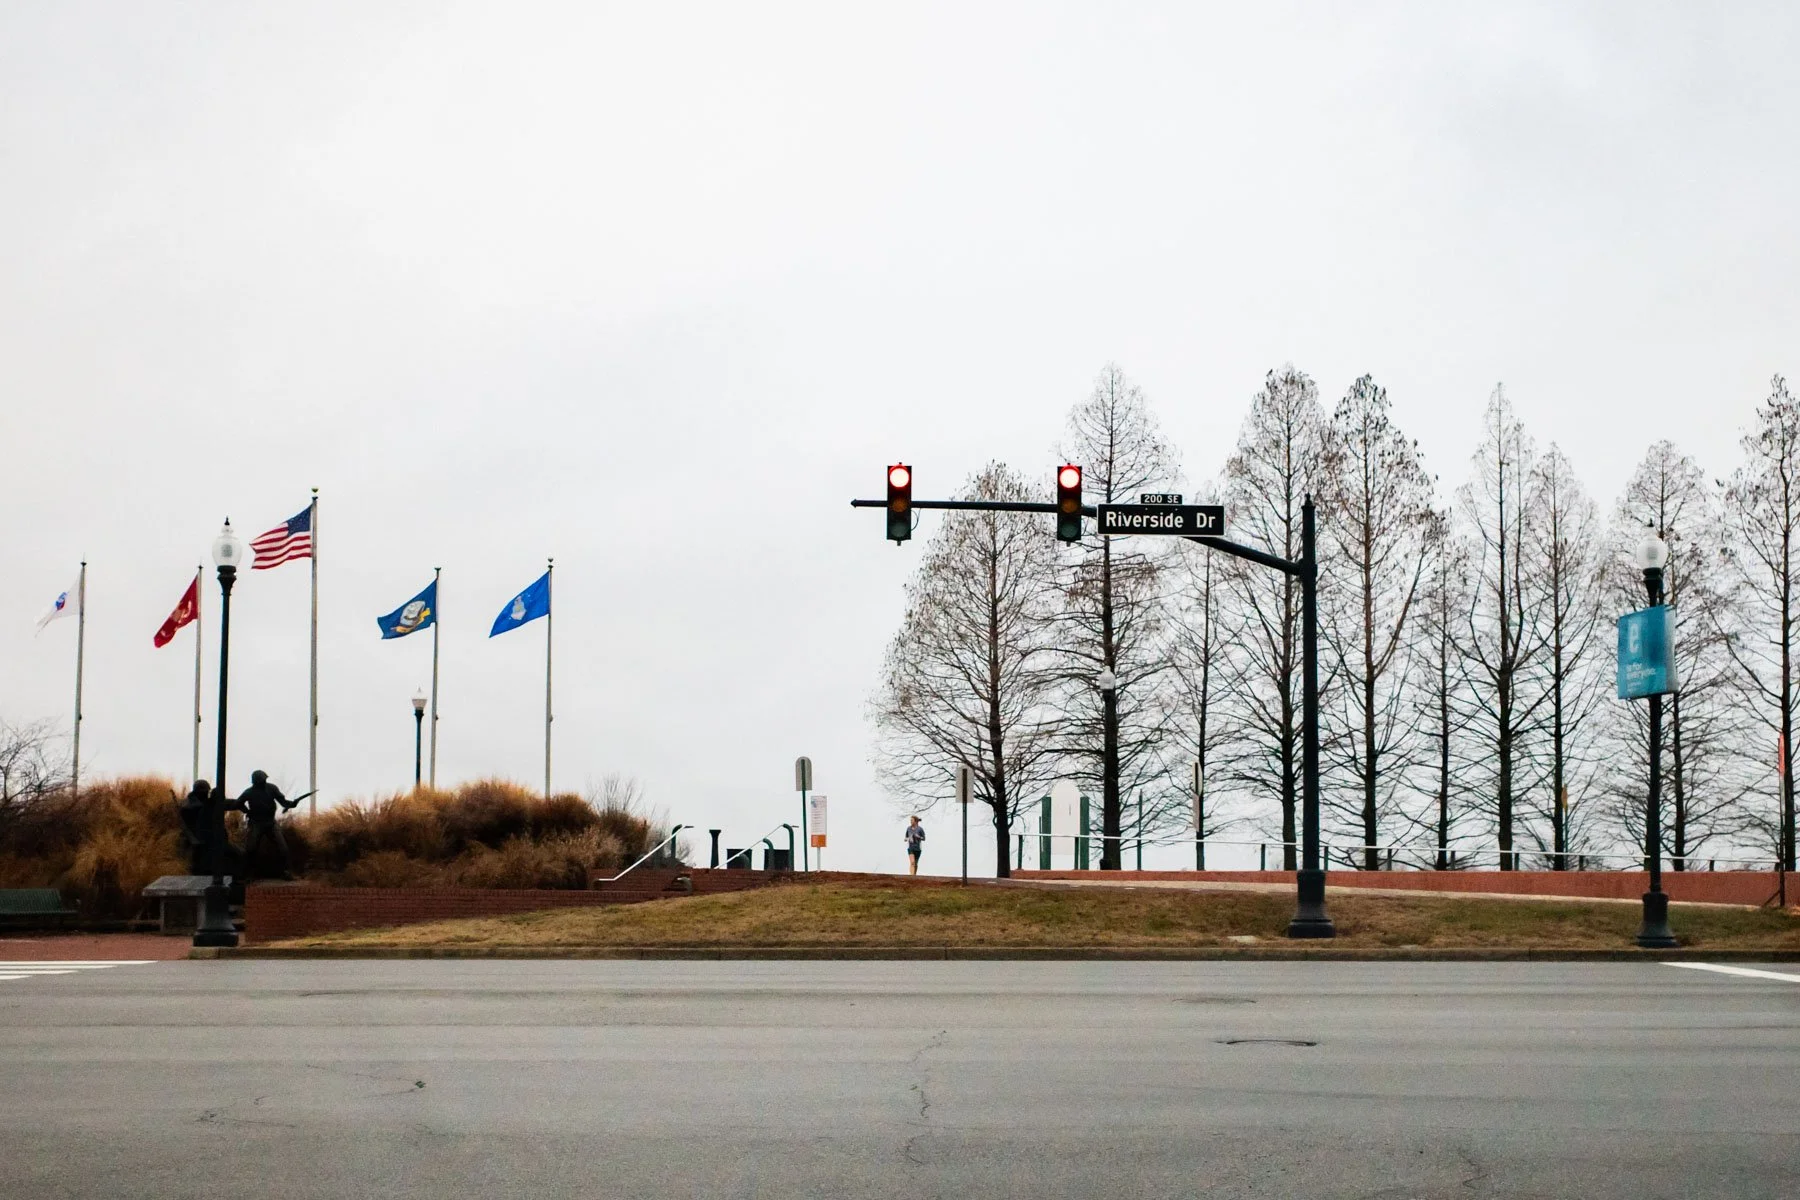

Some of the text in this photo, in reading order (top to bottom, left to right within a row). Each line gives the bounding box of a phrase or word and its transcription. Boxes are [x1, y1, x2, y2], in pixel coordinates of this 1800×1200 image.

[1144, 494, 1179, 503] 200 SE
[1106, 511, 1216, 528] Riverside Dr
